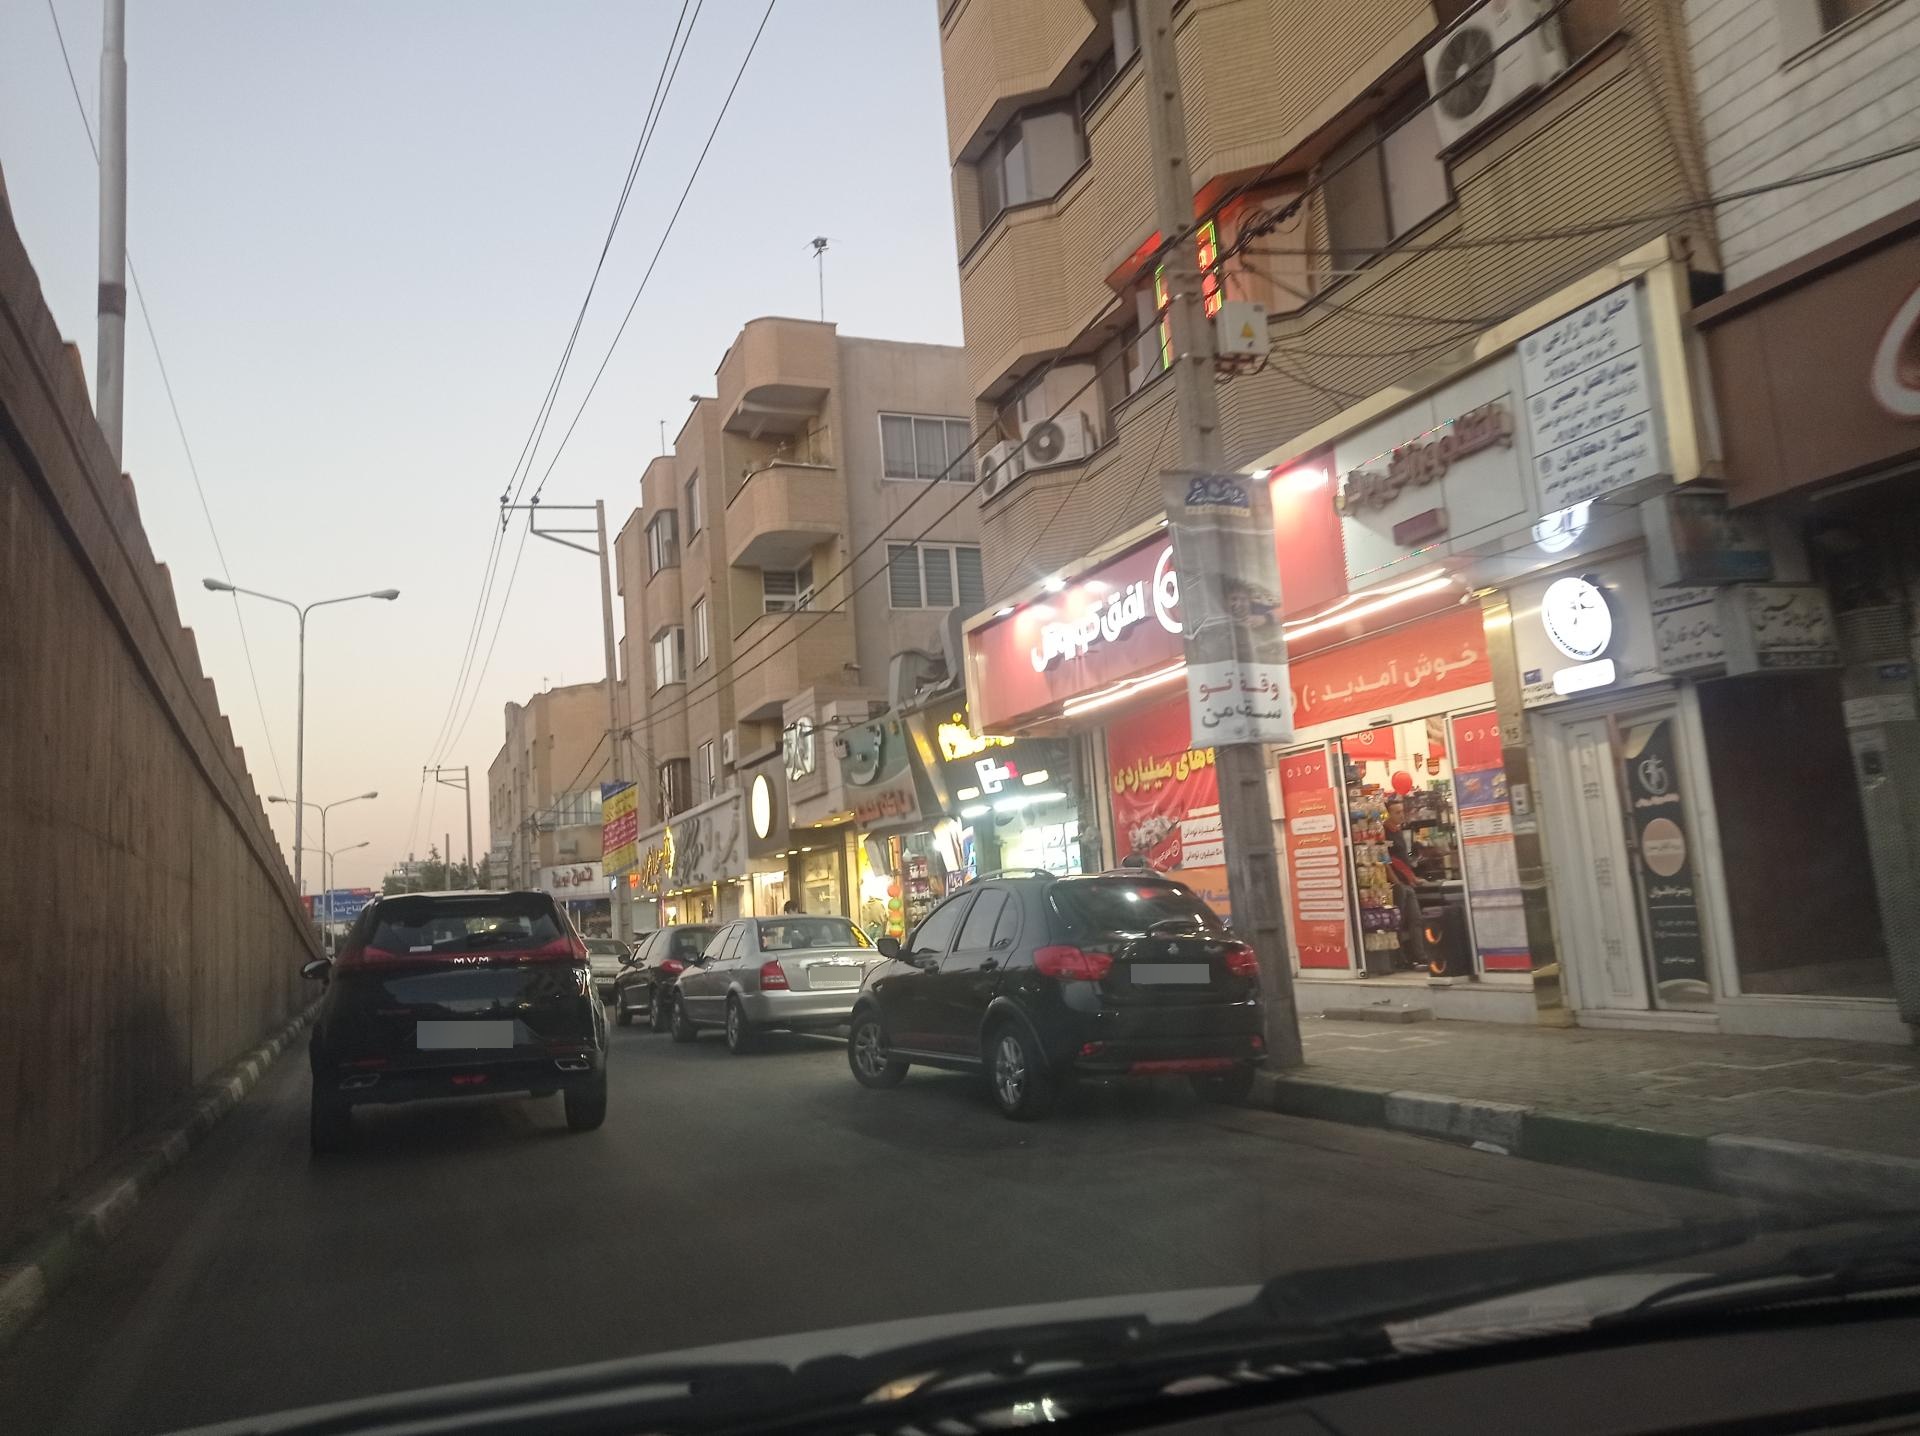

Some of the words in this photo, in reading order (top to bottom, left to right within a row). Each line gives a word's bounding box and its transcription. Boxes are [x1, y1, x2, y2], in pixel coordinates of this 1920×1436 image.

[1101, 579, 1147, 643] افق
[1321, 659, 1398, 705] آمدید
[1403, 642, 1478, 688] خوش
[1199, 673, 1233, 702] تو
[1202, 704, 1234, 729] من
[1114, 755, 1173, 794] میلیاردی
[453, 956, 490, 964] MVM
